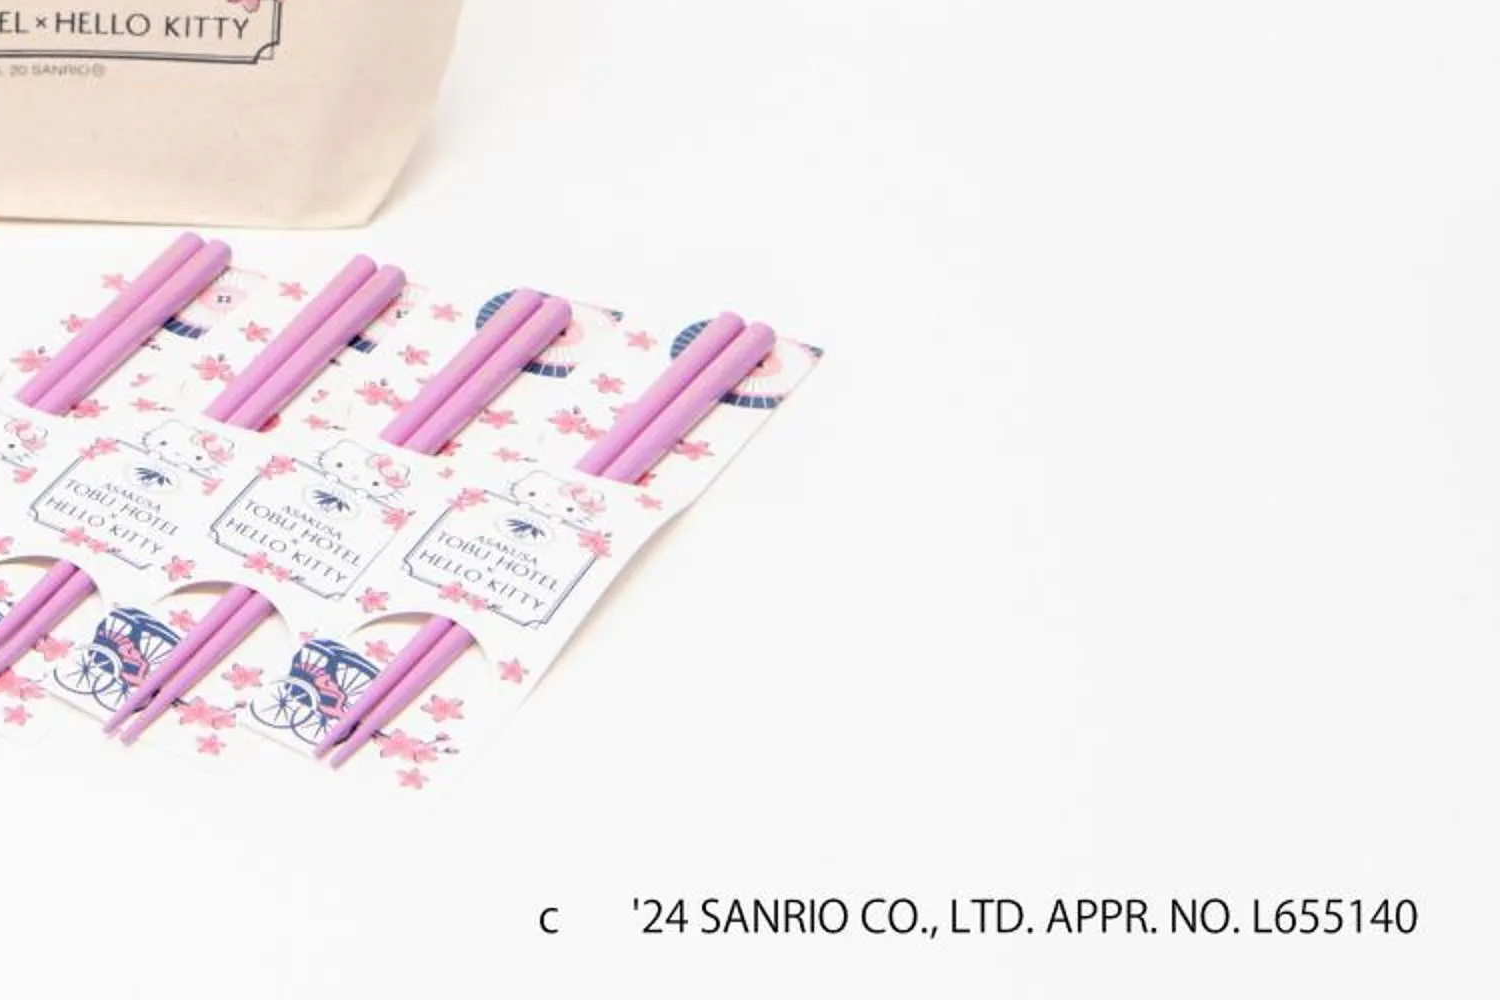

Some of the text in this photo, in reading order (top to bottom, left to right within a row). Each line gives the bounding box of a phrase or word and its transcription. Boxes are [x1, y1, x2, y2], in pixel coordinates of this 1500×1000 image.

[55, 12, 150, 37] HELLO
[164, 16, 249, 40] KITTY
[46, 496, 165, 554] HELLO KITTY
[66, 478, 179, 536] TOBU HOTEL
[245, 500, 361, 566] TOBU HOTEL
[226, 517, 348, 583] HELLO KITTY
[419, 549, 545, 610] HELLO KITTY
[438, 531, 557, 592] TOBU HOTEL
